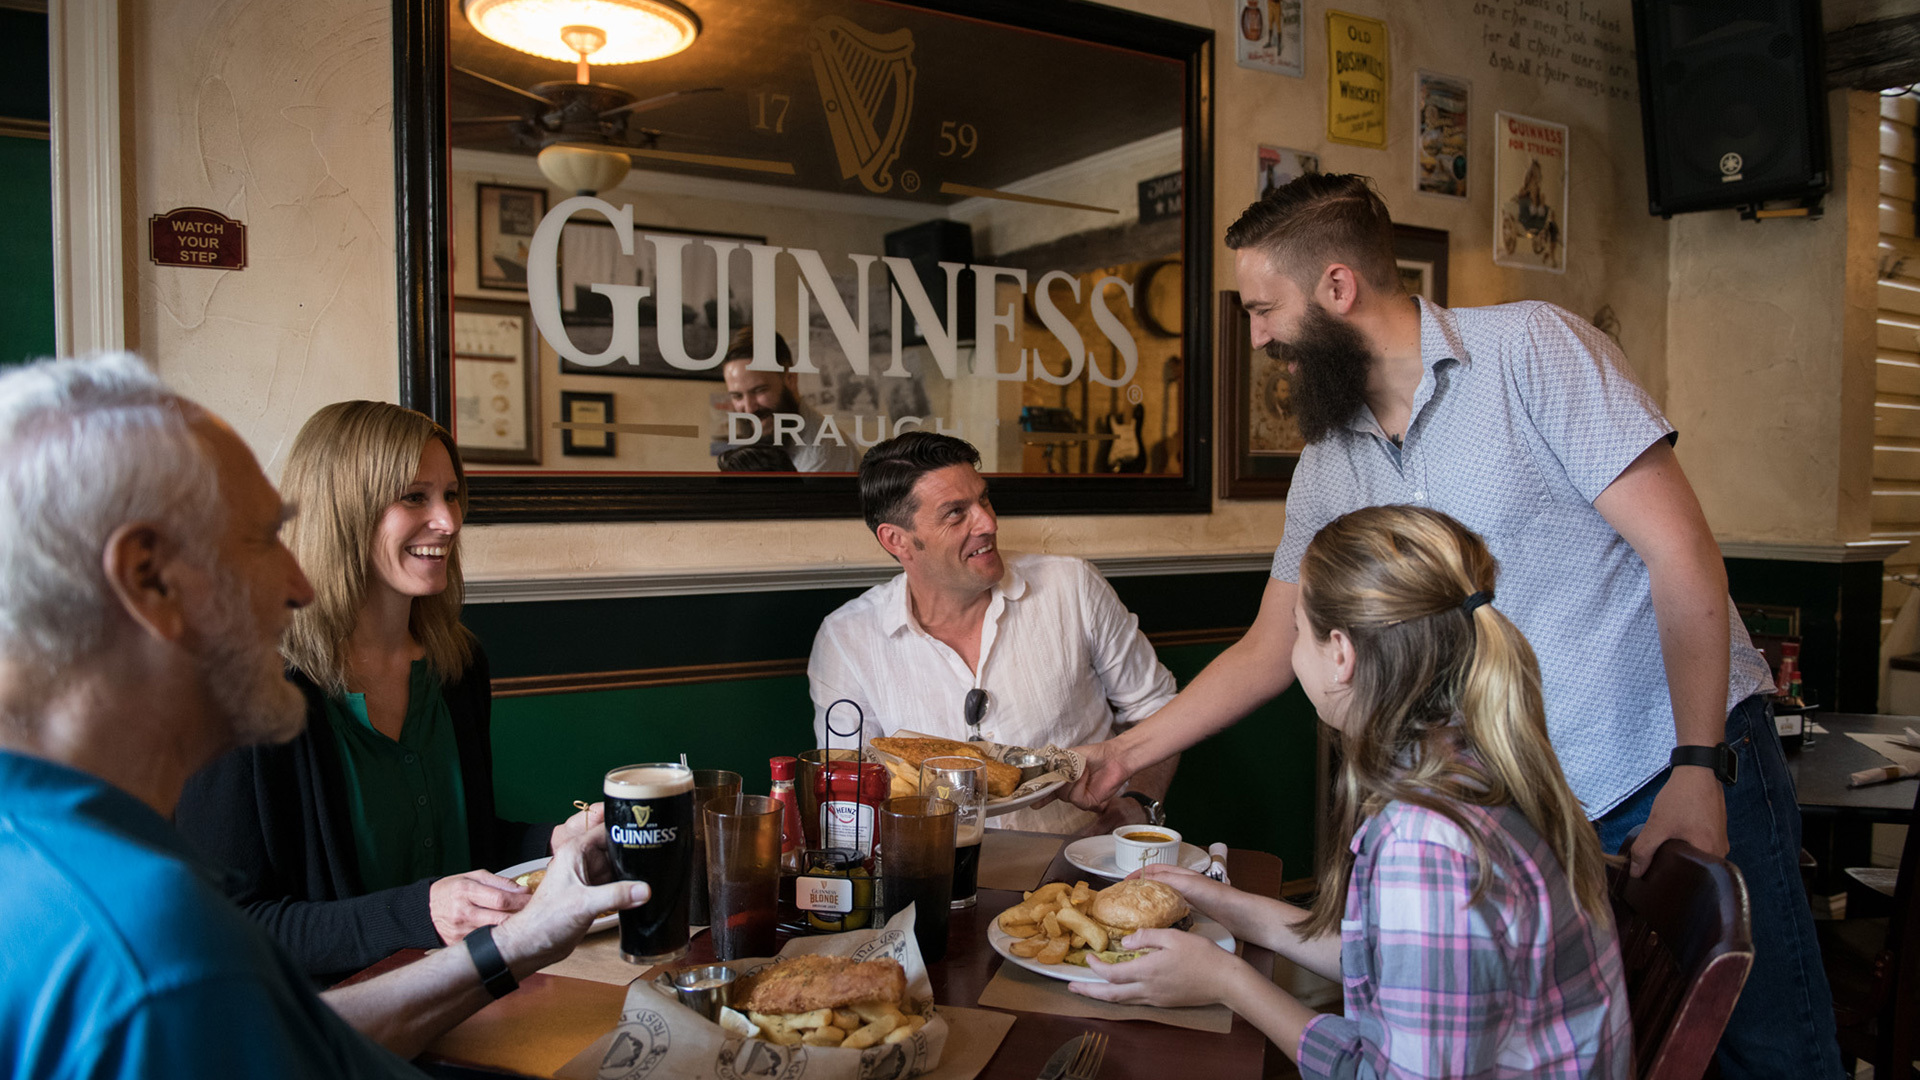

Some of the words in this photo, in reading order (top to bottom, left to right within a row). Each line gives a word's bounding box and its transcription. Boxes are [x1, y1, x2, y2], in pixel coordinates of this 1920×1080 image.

[1580, 2, 1620, 33] Ireland
[1348, 25, 1371, 43] OLD
[1336, 50, 1384, 81] BUSHMILLS
[1339, 81, 1380, 104] WHISKEY
[754, 92, 790, 134] 17
[938, 121, 978, 159] 59
[1508, 118, 1562, 144] GUINNESS
[1509, 138, 1524, 150] FOR
[172, 220, 223, 235] WATCH
[177, 235, 219, 249] YOUR
[180, 250, 217, 263] STEP
[526, 195, 1139, 388] GUINNESS
[836, 807, 857, 816] HEINZ
[611, 825, 677, 845] GUINNESS
[810, 893, 839, 905] BLONDE
